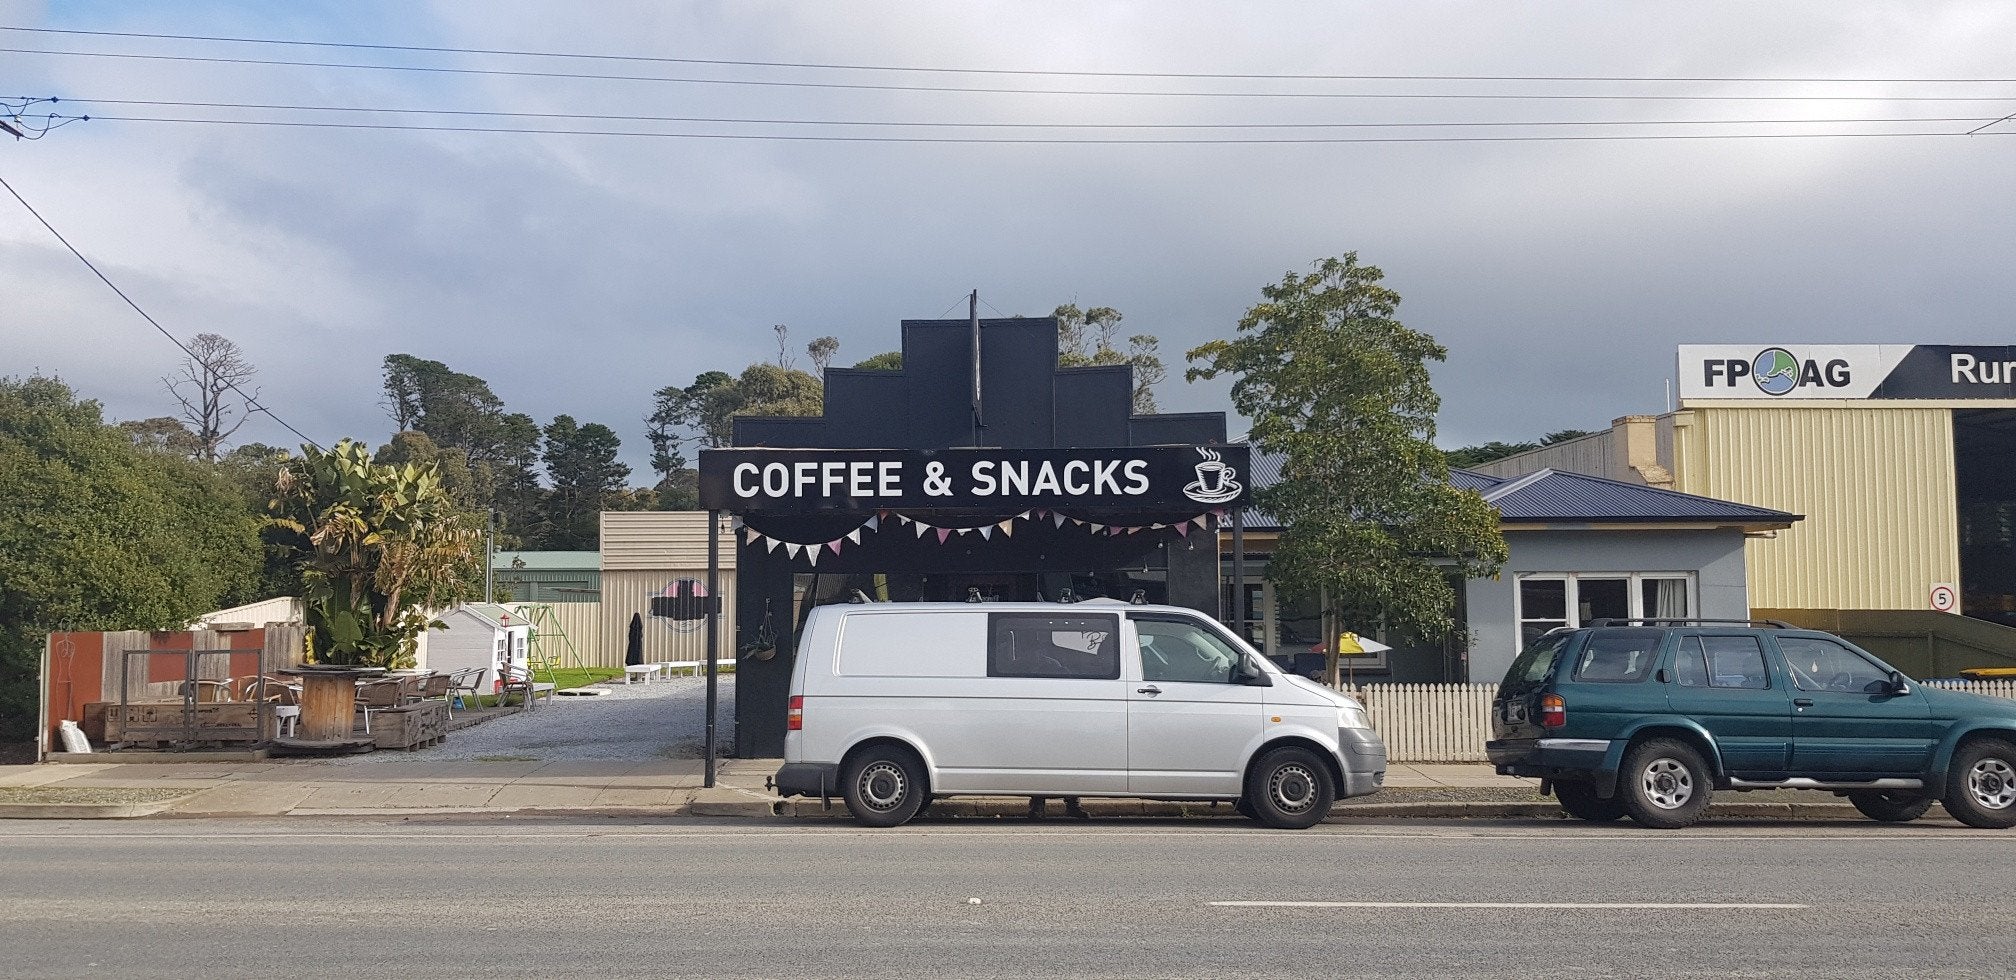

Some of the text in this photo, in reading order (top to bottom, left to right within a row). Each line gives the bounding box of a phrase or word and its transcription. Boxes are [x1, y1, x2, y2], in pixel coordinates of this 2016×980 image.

[1950, 353, 2016, 384] Rur
[733, 459, 1150, 498] COFFEE & SNACKS
[1938, 593, 1947, 605] 5
